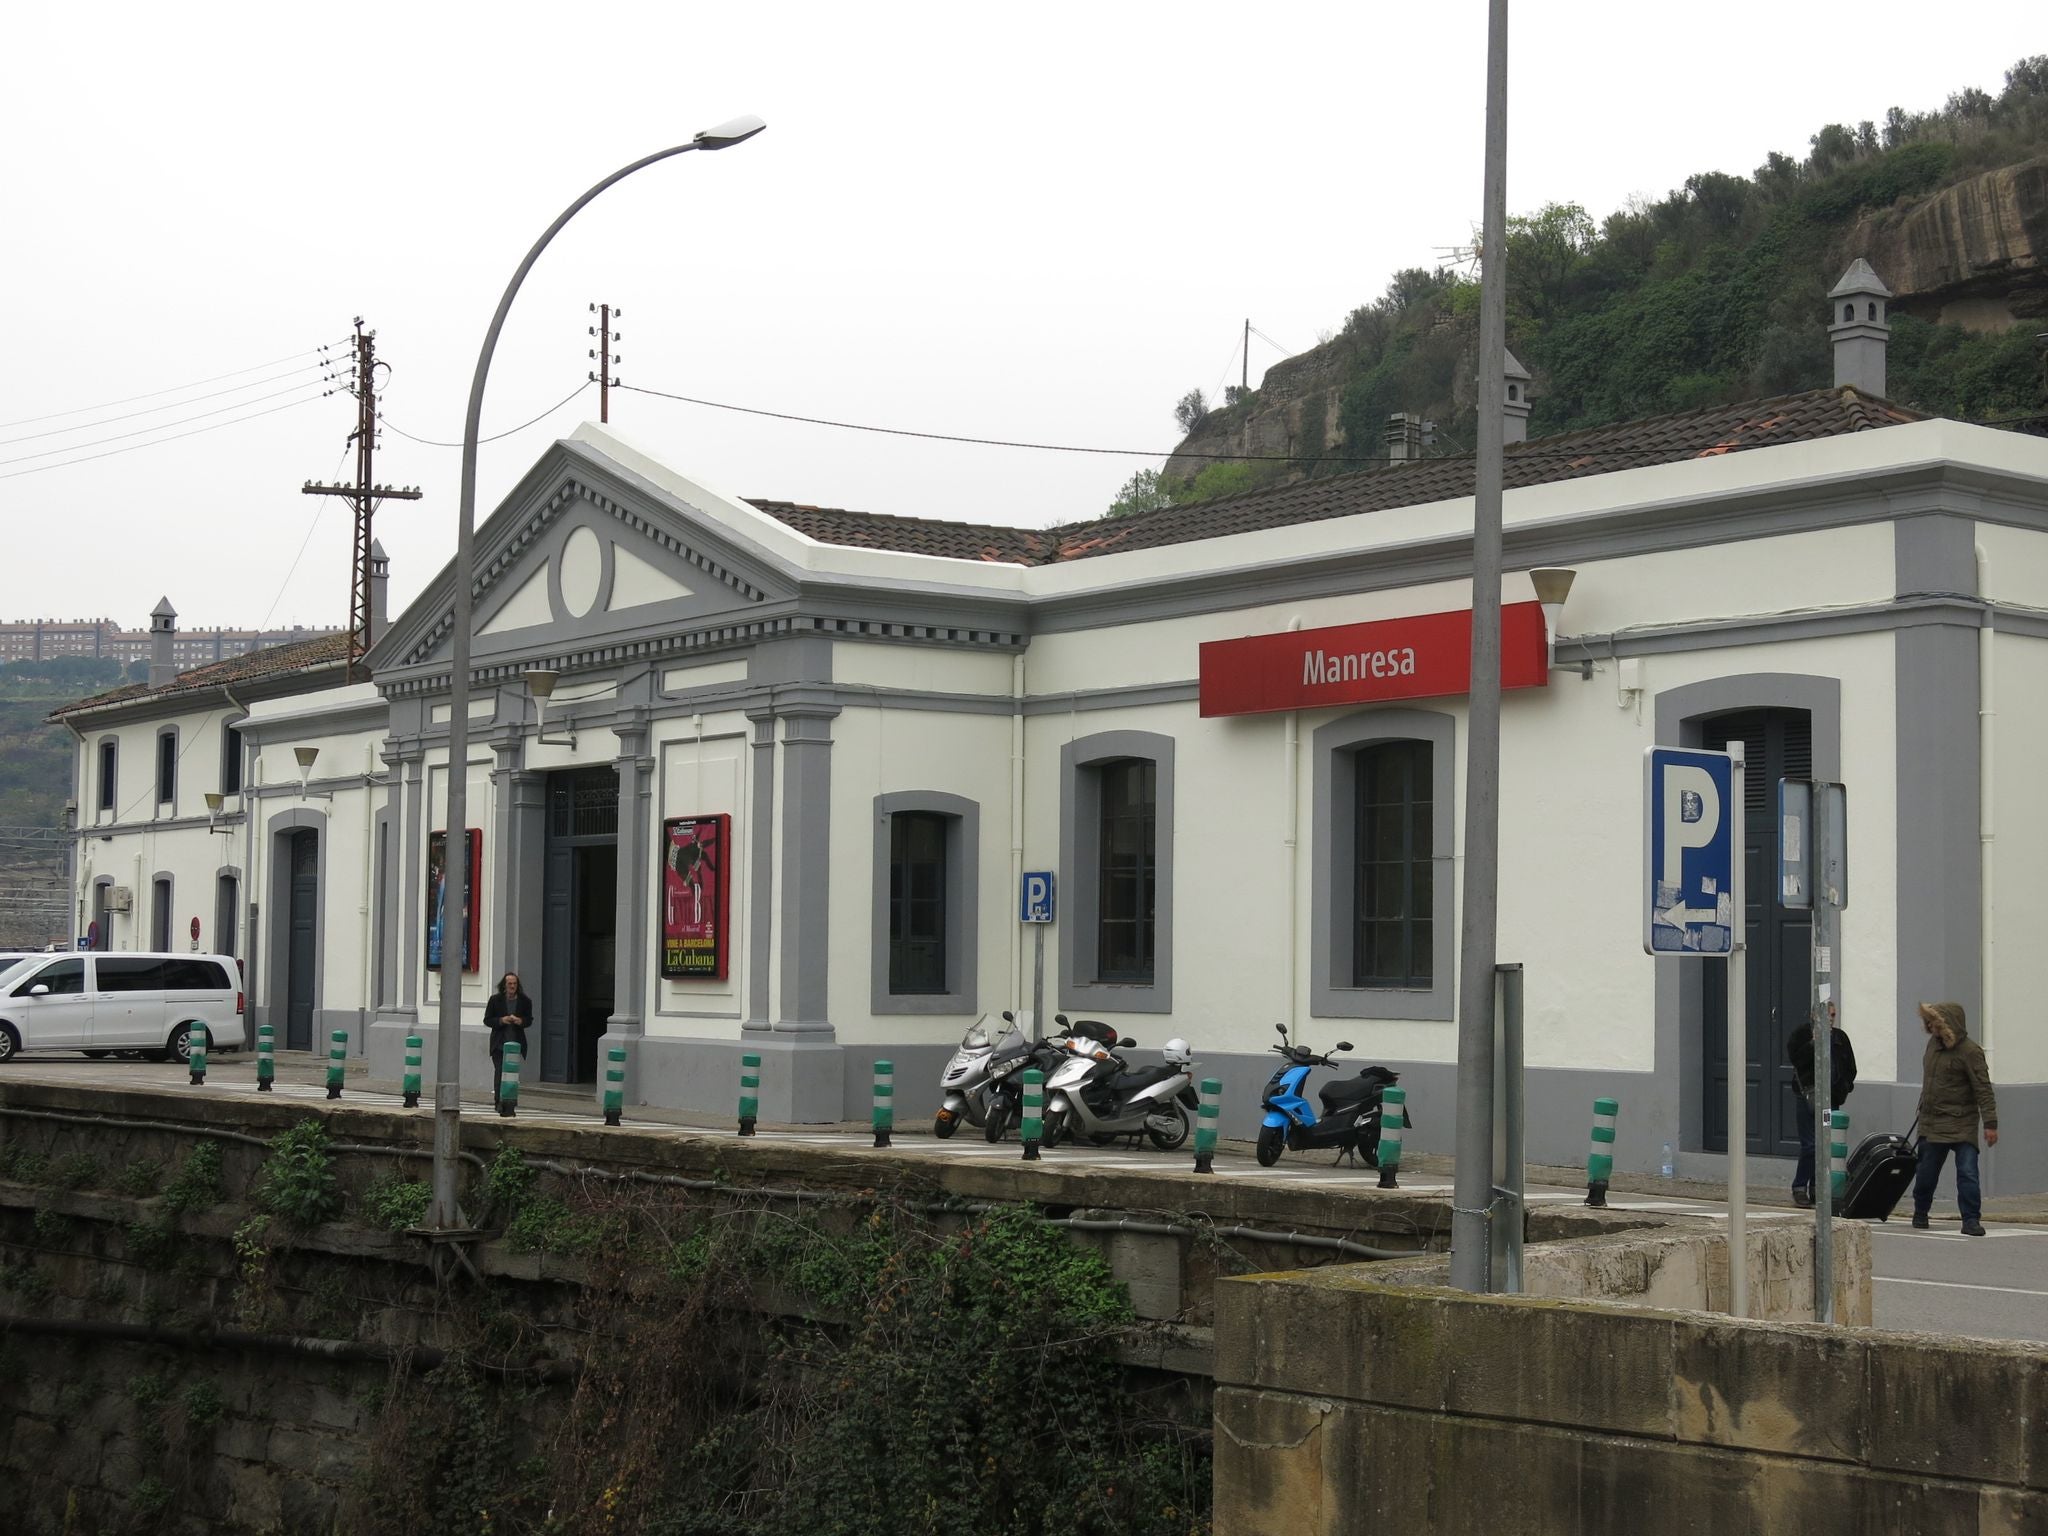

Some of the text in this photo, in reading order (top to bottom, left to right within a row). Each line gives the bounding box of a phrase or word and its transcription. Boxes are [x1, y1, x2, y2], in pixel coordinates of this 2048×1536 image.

[1303, 647, 1415, 686] Manresa
[1664, 764, 1720, 889] P
[1028, 877, 1046, 916] P
